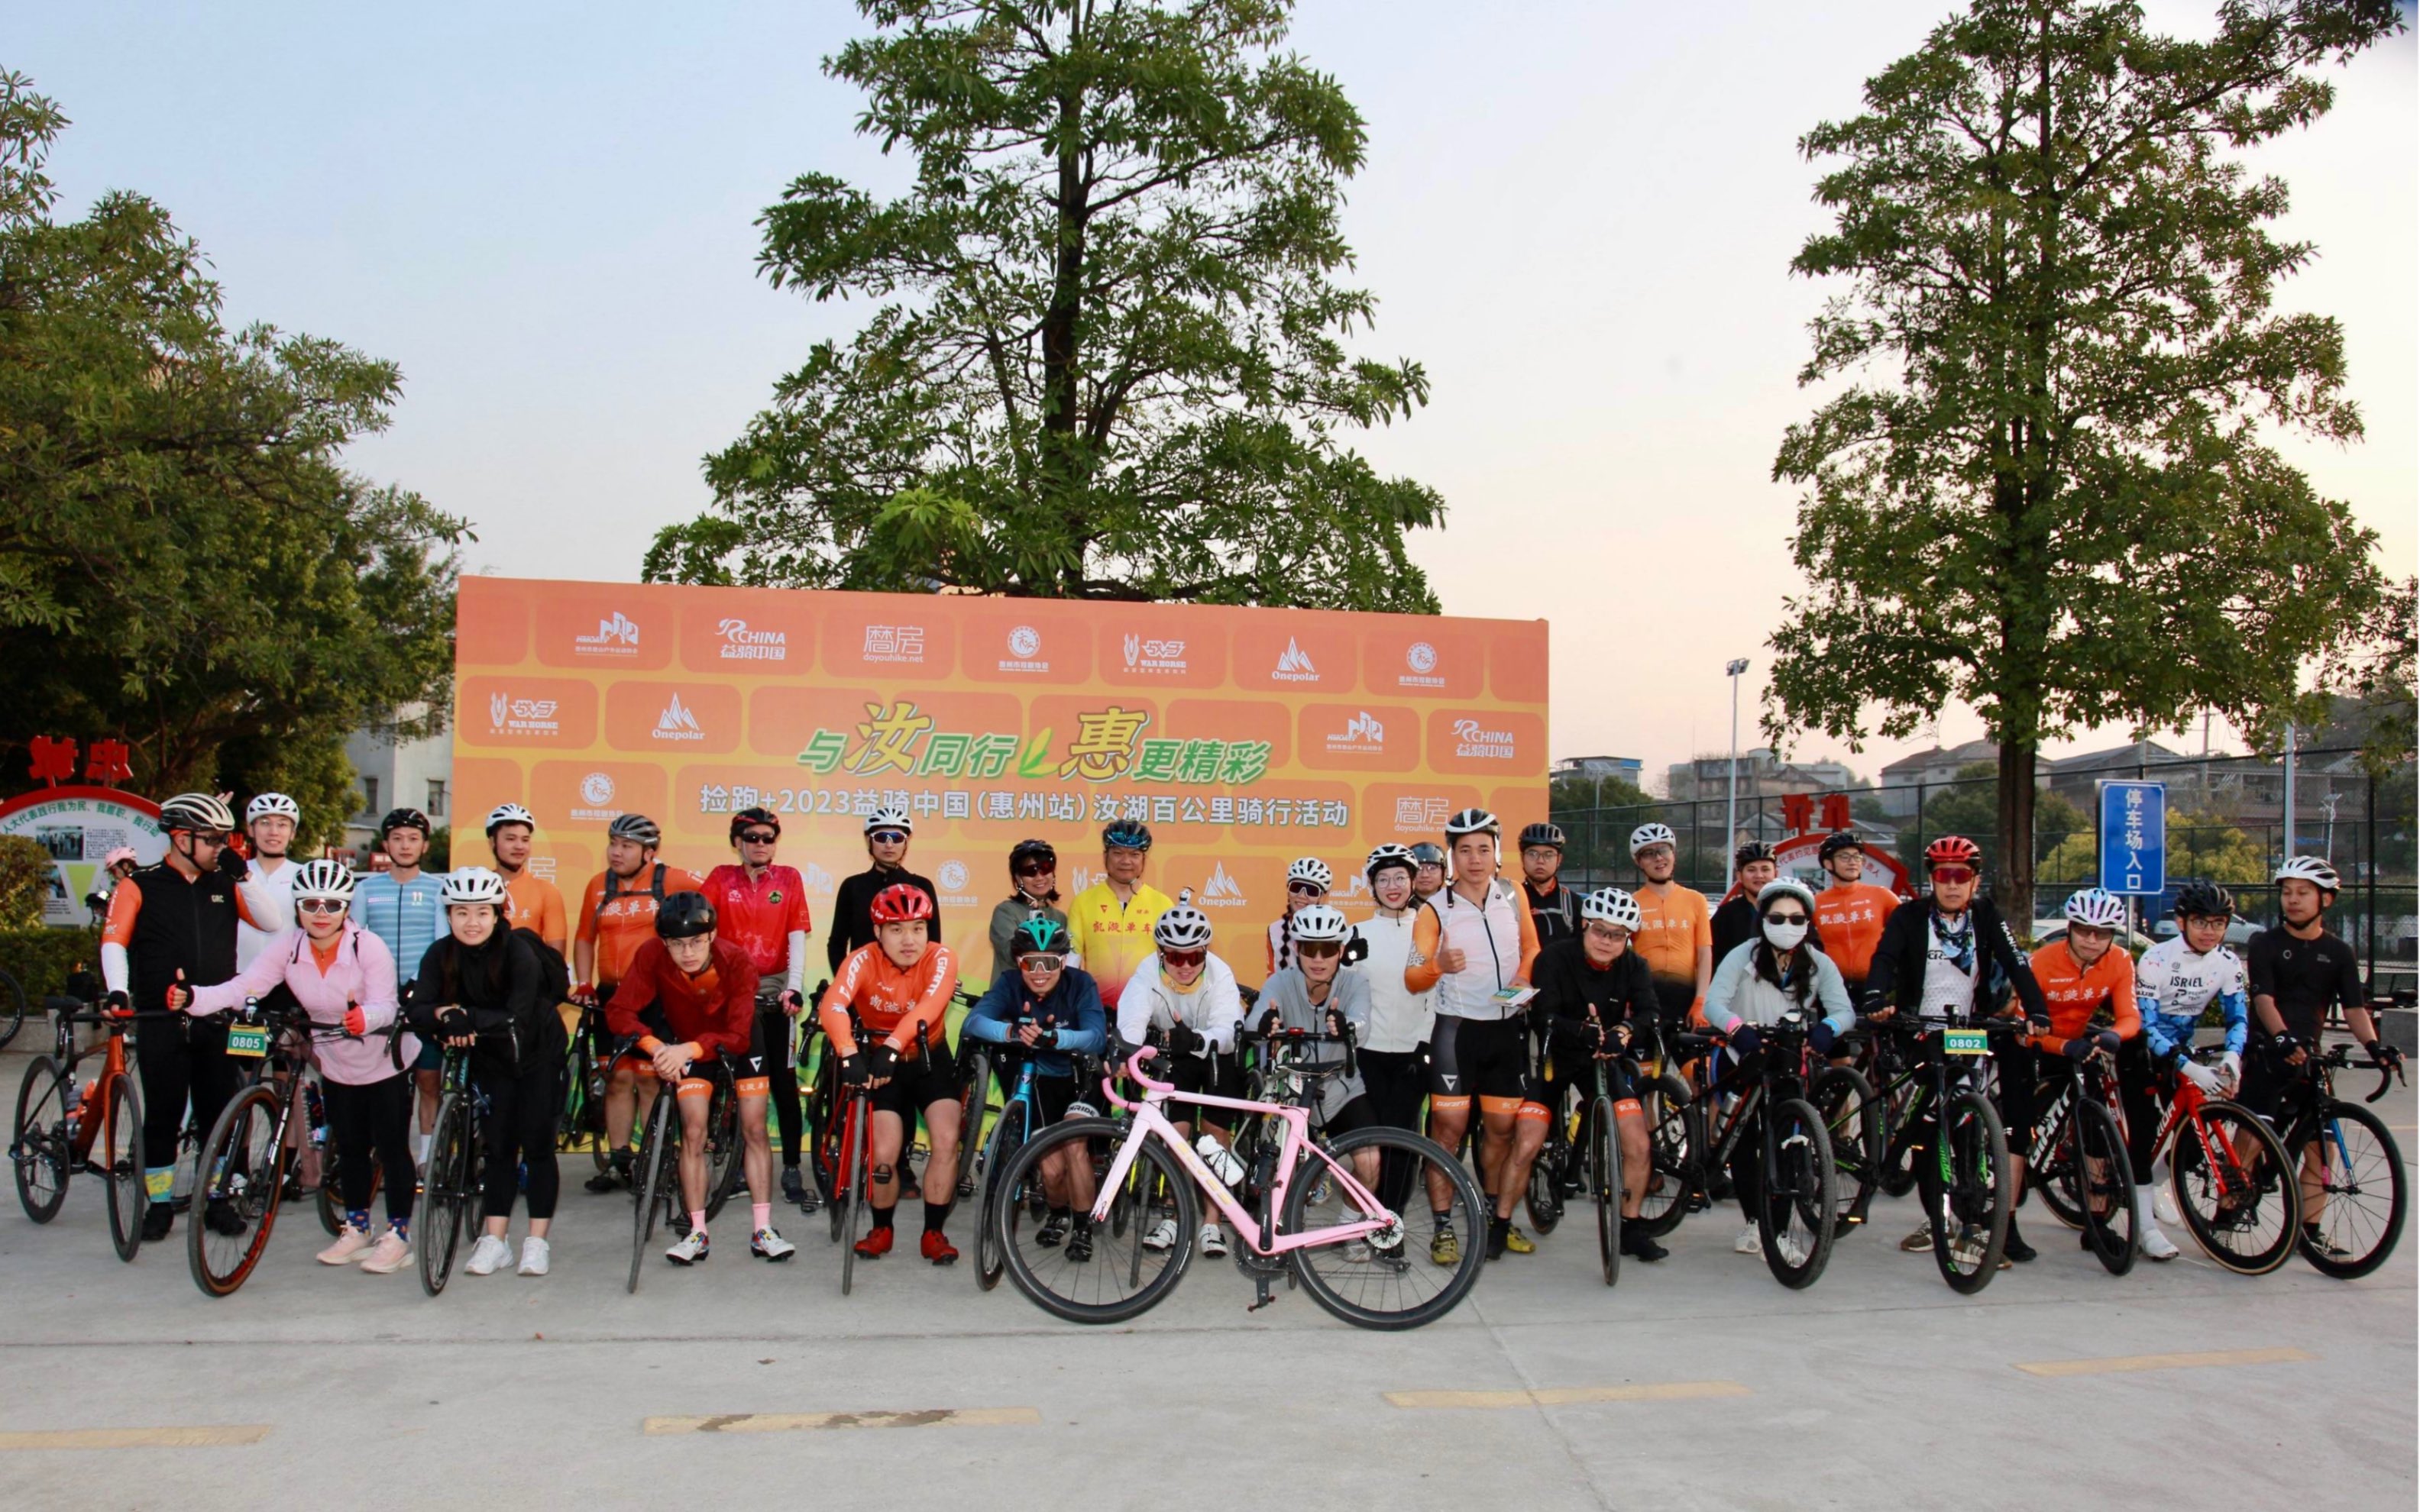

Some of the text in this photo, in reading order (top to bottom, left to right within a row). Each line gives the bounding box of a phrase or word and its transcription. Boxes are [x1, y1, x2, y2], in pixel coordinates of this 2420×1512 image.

[863, 654, 924, 663] doyouhike.net
[1271, 670, 1320, 682] Onepolar
[508, 720, 558, 729] WAR HORSE
[652, 729, 706, 740] Onepolar
[797, 702, 1273, 784] 与汝同行 惠更精彩
[2125, 788, 2143, 890] 停车场入口
[1199, 897, 1247, 907] Onepolar
[847, 949, 869, 991] GIANT
[926, 956, 948, 997] GIANT
[232, 1036, 260, 1048] 0805
[1949, 1039, 1982, 1048] 0802
